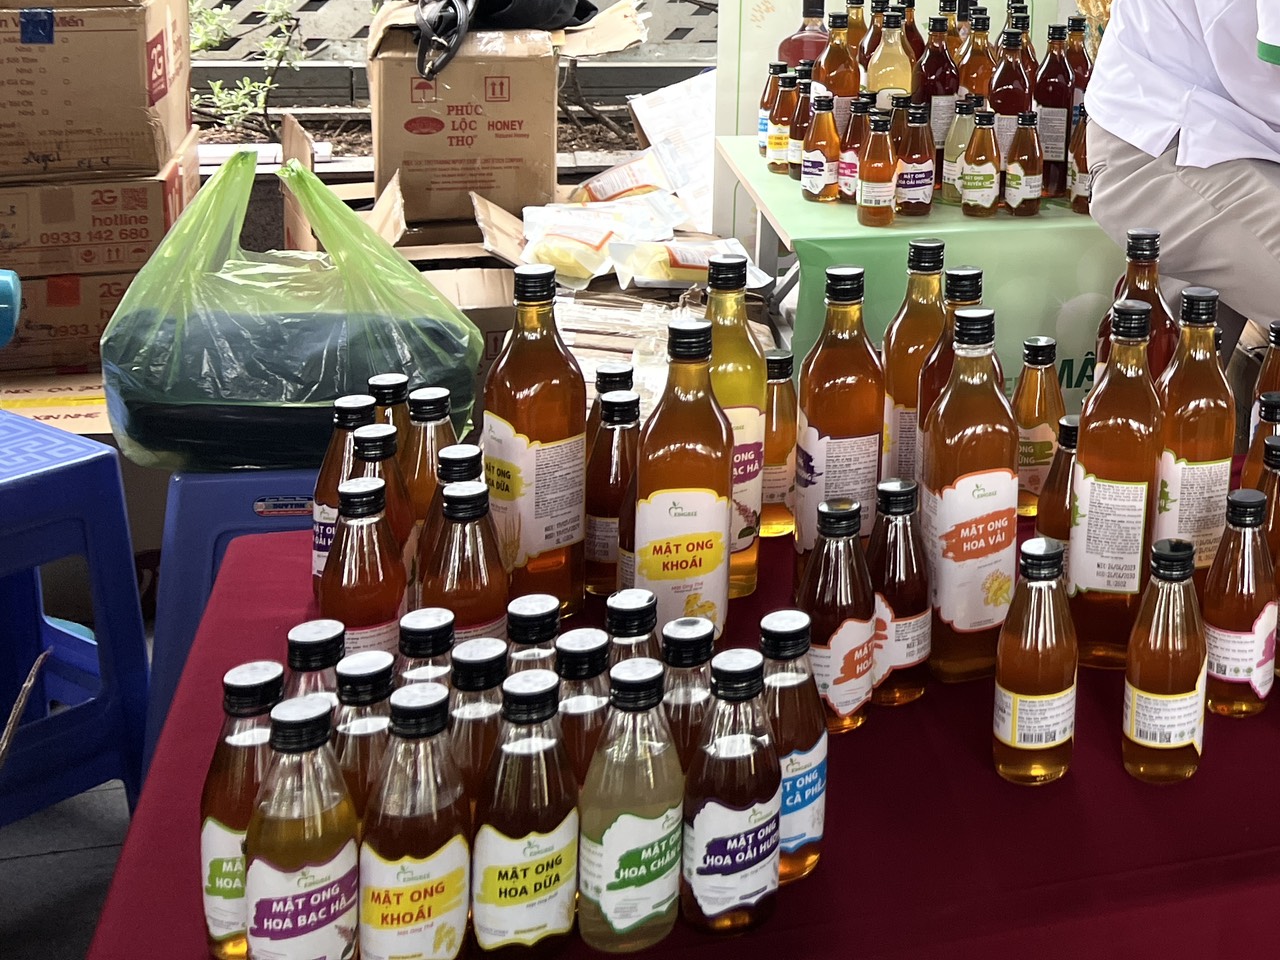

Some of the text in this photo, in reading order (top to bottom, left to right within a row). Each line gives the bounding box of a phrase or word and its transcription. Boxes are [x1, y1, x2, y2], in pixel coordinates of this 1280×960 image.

[447, 102, 483, 116] PHÚC
[451, 118, 524, 133] LỘC HONEY
[447, 135, 474, 149] THỌ
[91, 189, 117, 206] 2G
[91, 213, 148, 226] hotline
[39, 228, 149, 244] 0933 142 680
[1058, 351, 1095, 393] MẬ
[734, 451, 755, 463] ONG
[496, 468, 511, 480] ONG
[733, 467, 745, 479] ẠC
[960, 518, 1008, 542] MẬT ONG
[652, 540, 713, 558] MẬT ONG
[963, 530, 1005, 552] HOA VẢI
[662, 555, 702, 571] KHOÁI
[796, 771, 819, 788] ONG
[726, 819, 777, 852] MẬT ONG
[641, 839, 668, 861] MẬT
[222, 861, 243, 874] MẬ
[706, 854, 732, 866] HOA
[497, 854, 563, 885] MẬT ONG
[619, 866, 647, 879] HOA
[215, 877, 242, 888] HOA
[271, 883, 340, 916] MẬT ONG
[370, 881, 445, 909] MẬT ONG
[498, 887, 528, 899] HOA
[263, 917, 293, 930] HOA
[297, 908, 327, 927] BẠC
[381, 905, 433, 926] KHOÁI
